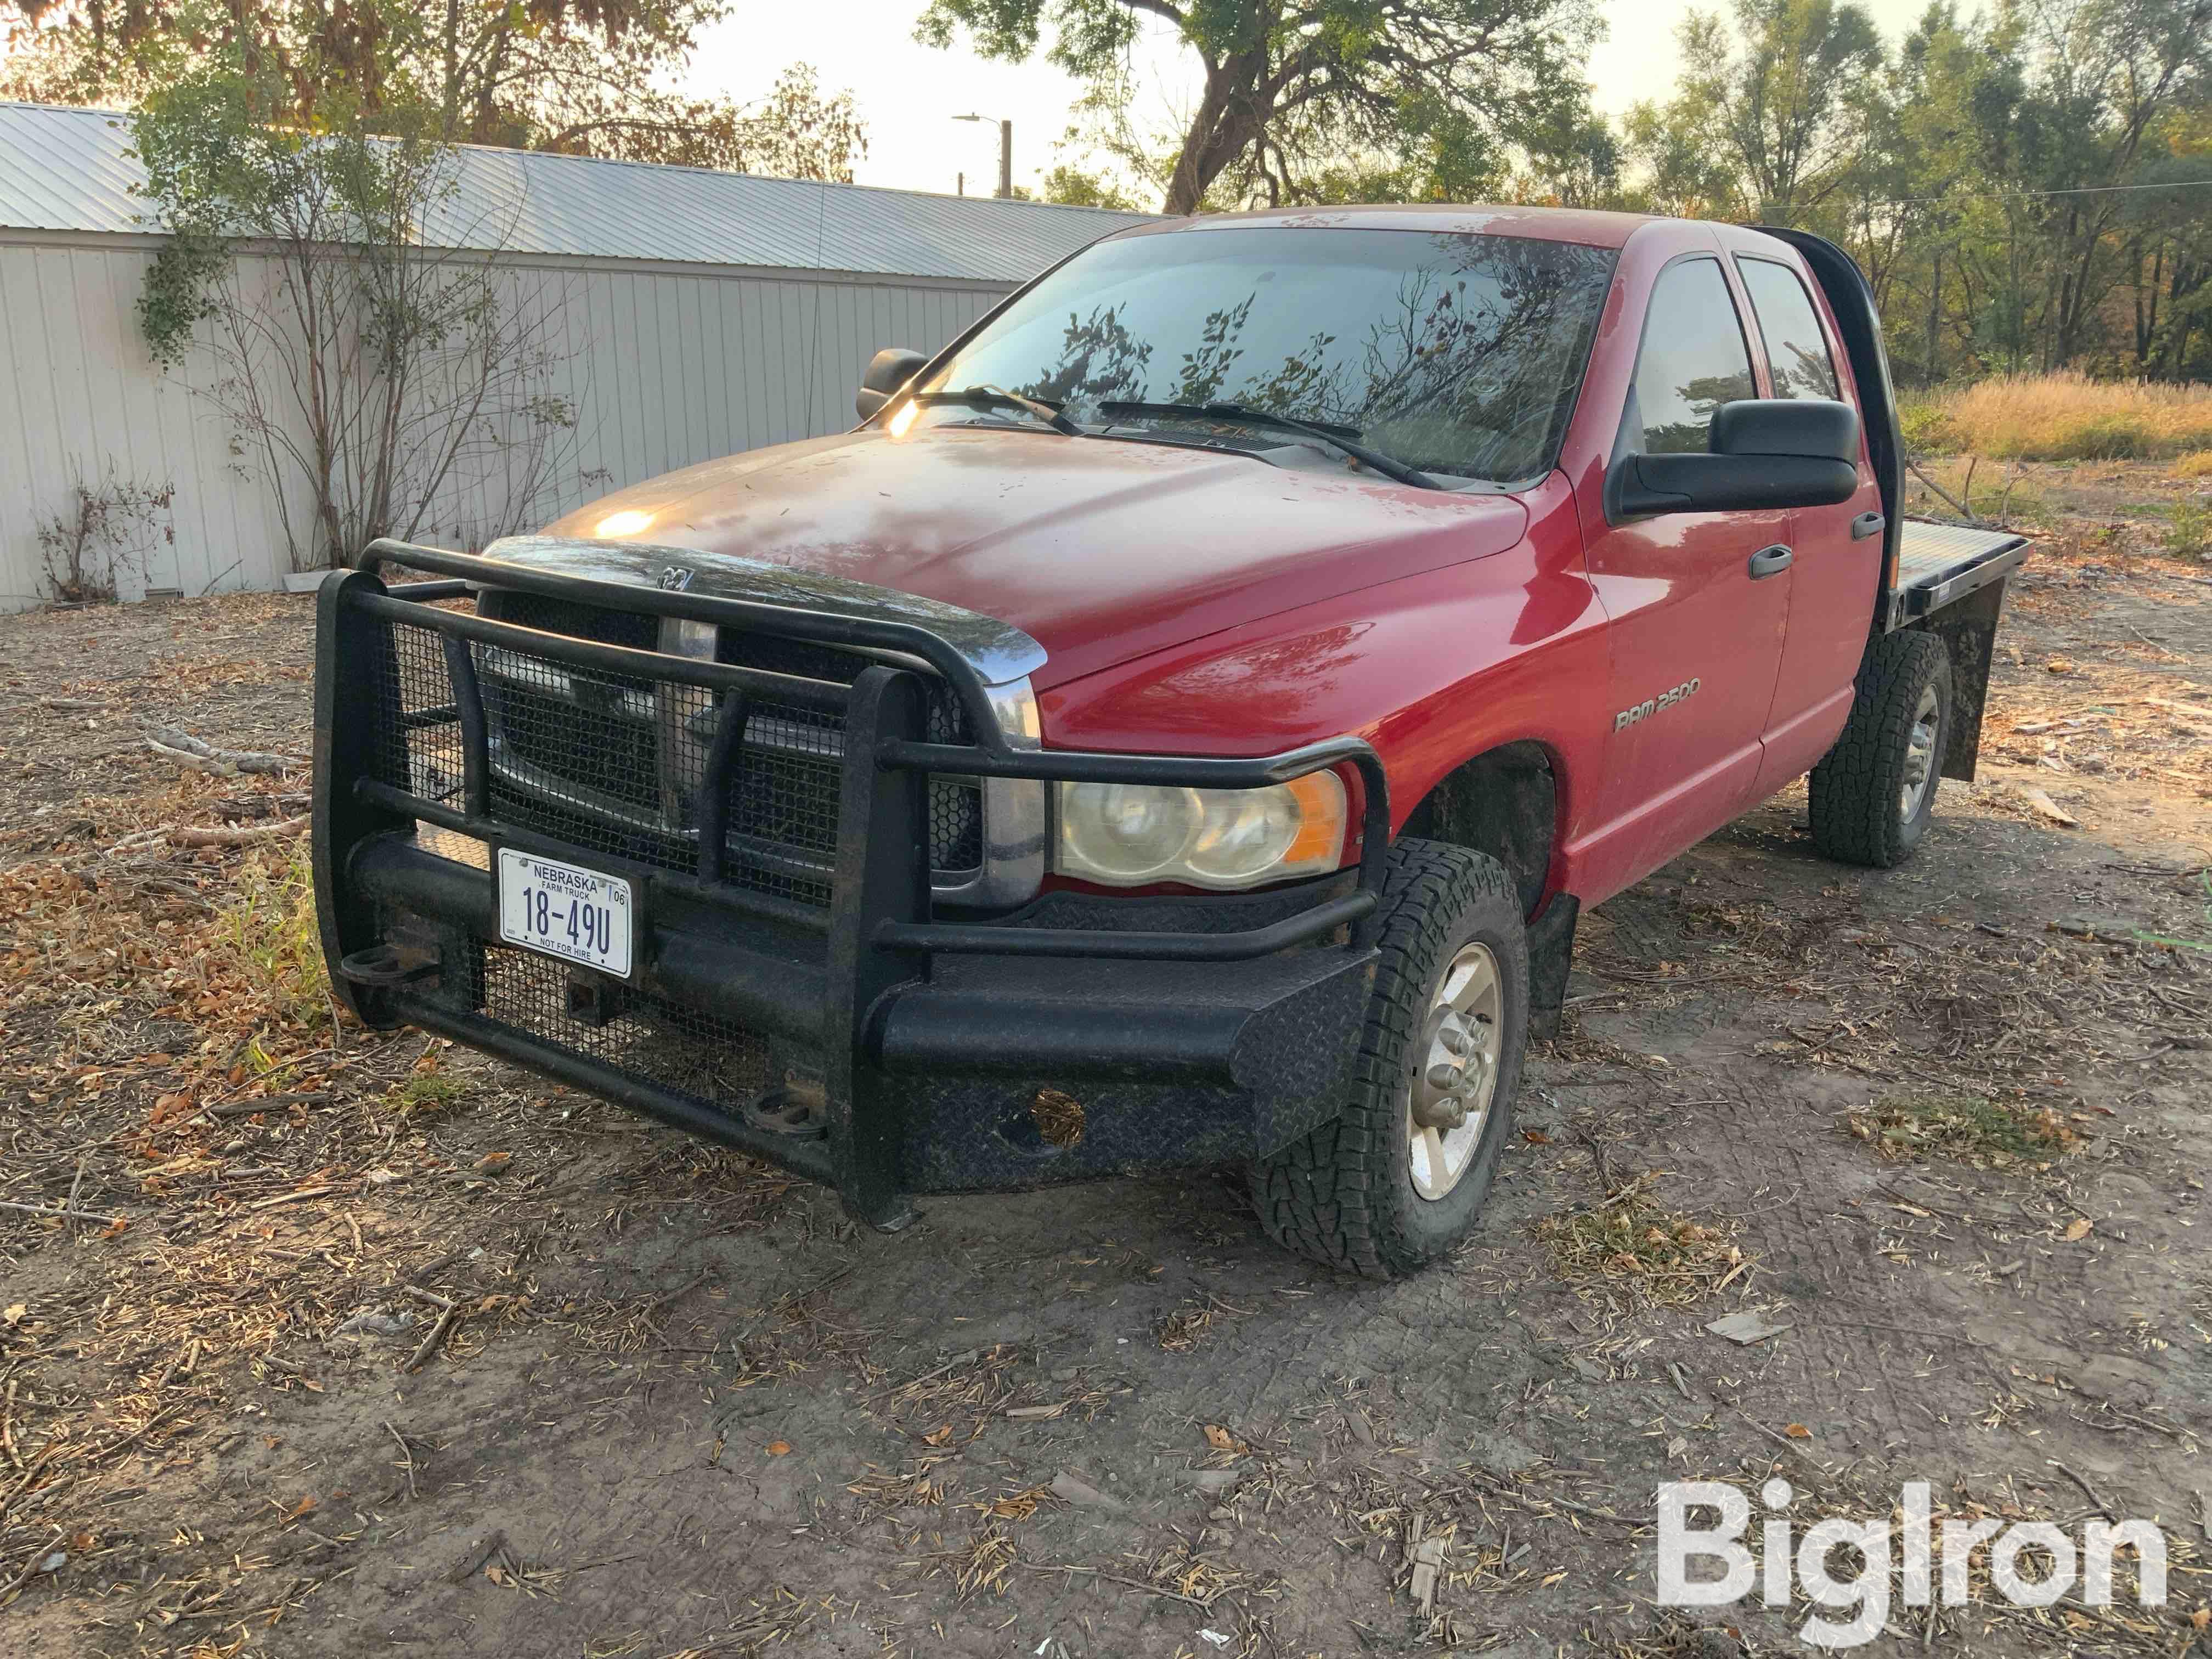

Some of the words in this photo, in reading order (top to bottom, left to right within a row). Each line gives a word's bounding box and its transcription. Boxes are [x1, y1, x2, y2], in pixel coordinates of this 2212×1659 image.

[1656, 678, 1700, 712] 2500
[534, 865, 597, 893] NEBRASKA
[541, 881, 562, 893] FARM
[565, 887, 590, 901] TRUCK
[614, 891, 625, 905] 06
[523, 887, 610, 955] 18-49U
[540, 938, 554, 947] NOT
[557, 943, 572, 953] FOR
[574, 949, 591, 960] HIRE
